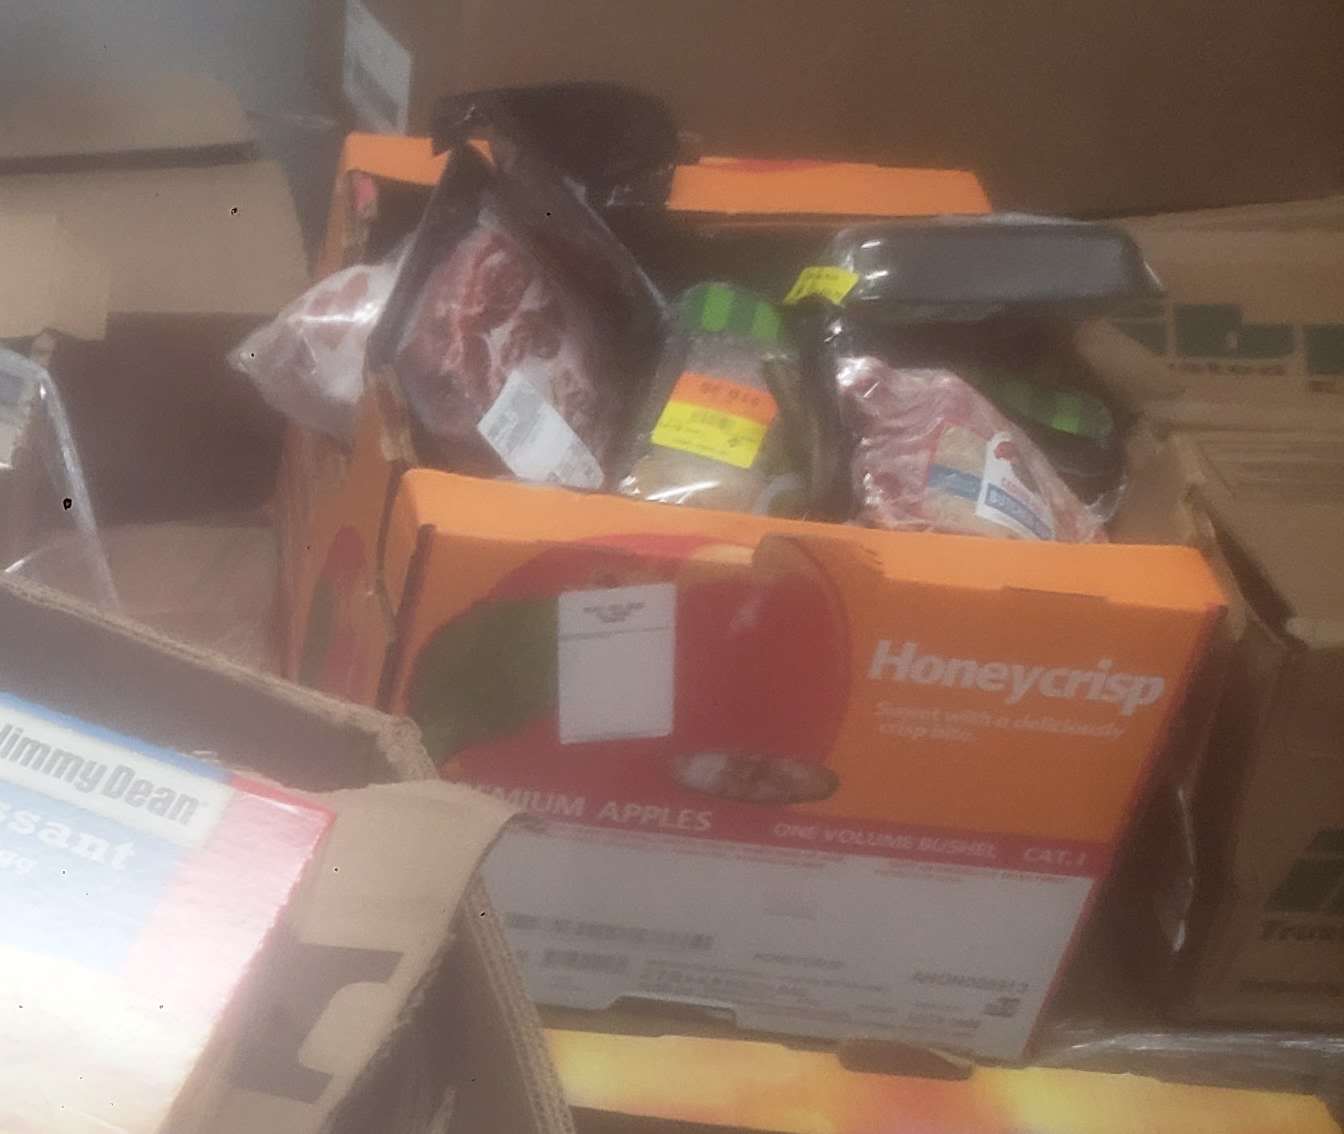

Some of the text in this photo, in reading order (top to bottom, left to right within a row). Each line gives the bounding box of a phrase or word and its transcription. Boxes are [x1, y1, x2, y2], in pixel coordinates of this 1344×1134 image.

[867, 638, 1166, 714] Honeycrisp
[109, 767, 201, 827] Dean
[598, 799, 713, 833] APPLES
[772, 821, 816, 840] ONE
[823, 826, 913, 850] VOLUME
[918, 835, 997, 858] BUSHEL
